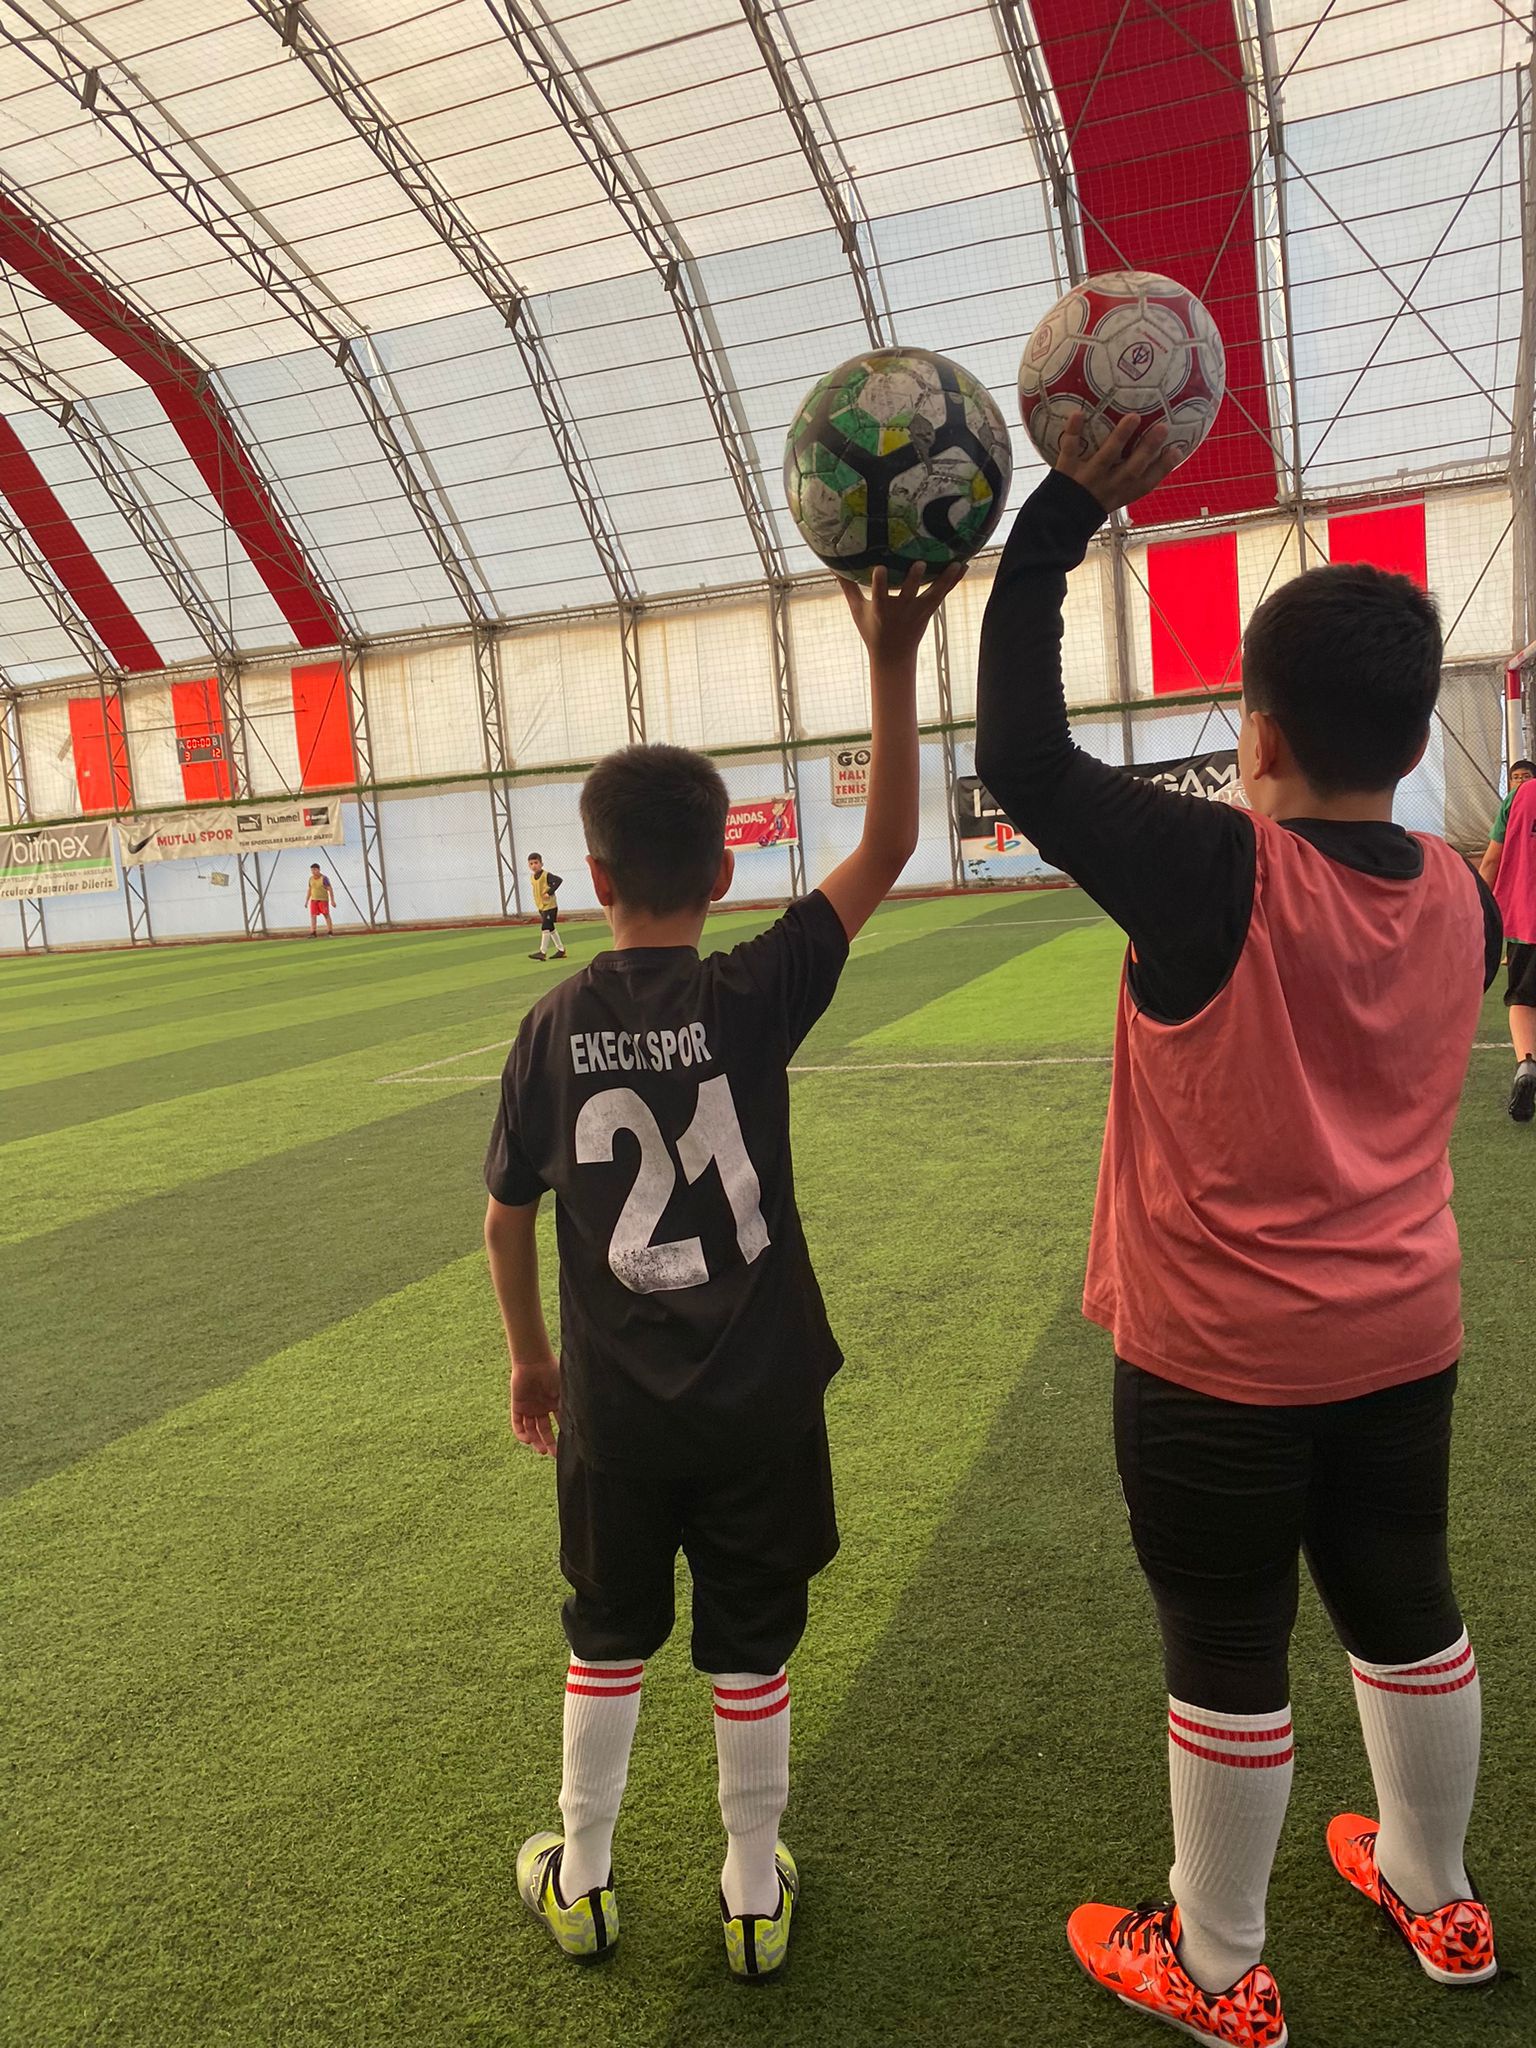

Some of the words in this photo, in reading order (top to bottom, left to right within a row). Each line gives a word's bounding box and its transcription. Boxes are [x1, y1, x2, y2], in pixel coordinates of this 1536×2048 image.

[266, 807, 301, 825] hummel
[10, 834, 92, 864] bitmex
[157, 833, 196, 846] MUTLU
[199, 828, 233, 842] SPOR
[646, 1021, 713, 1073] SPOR
[575, 1073, 772, 1295] 21
